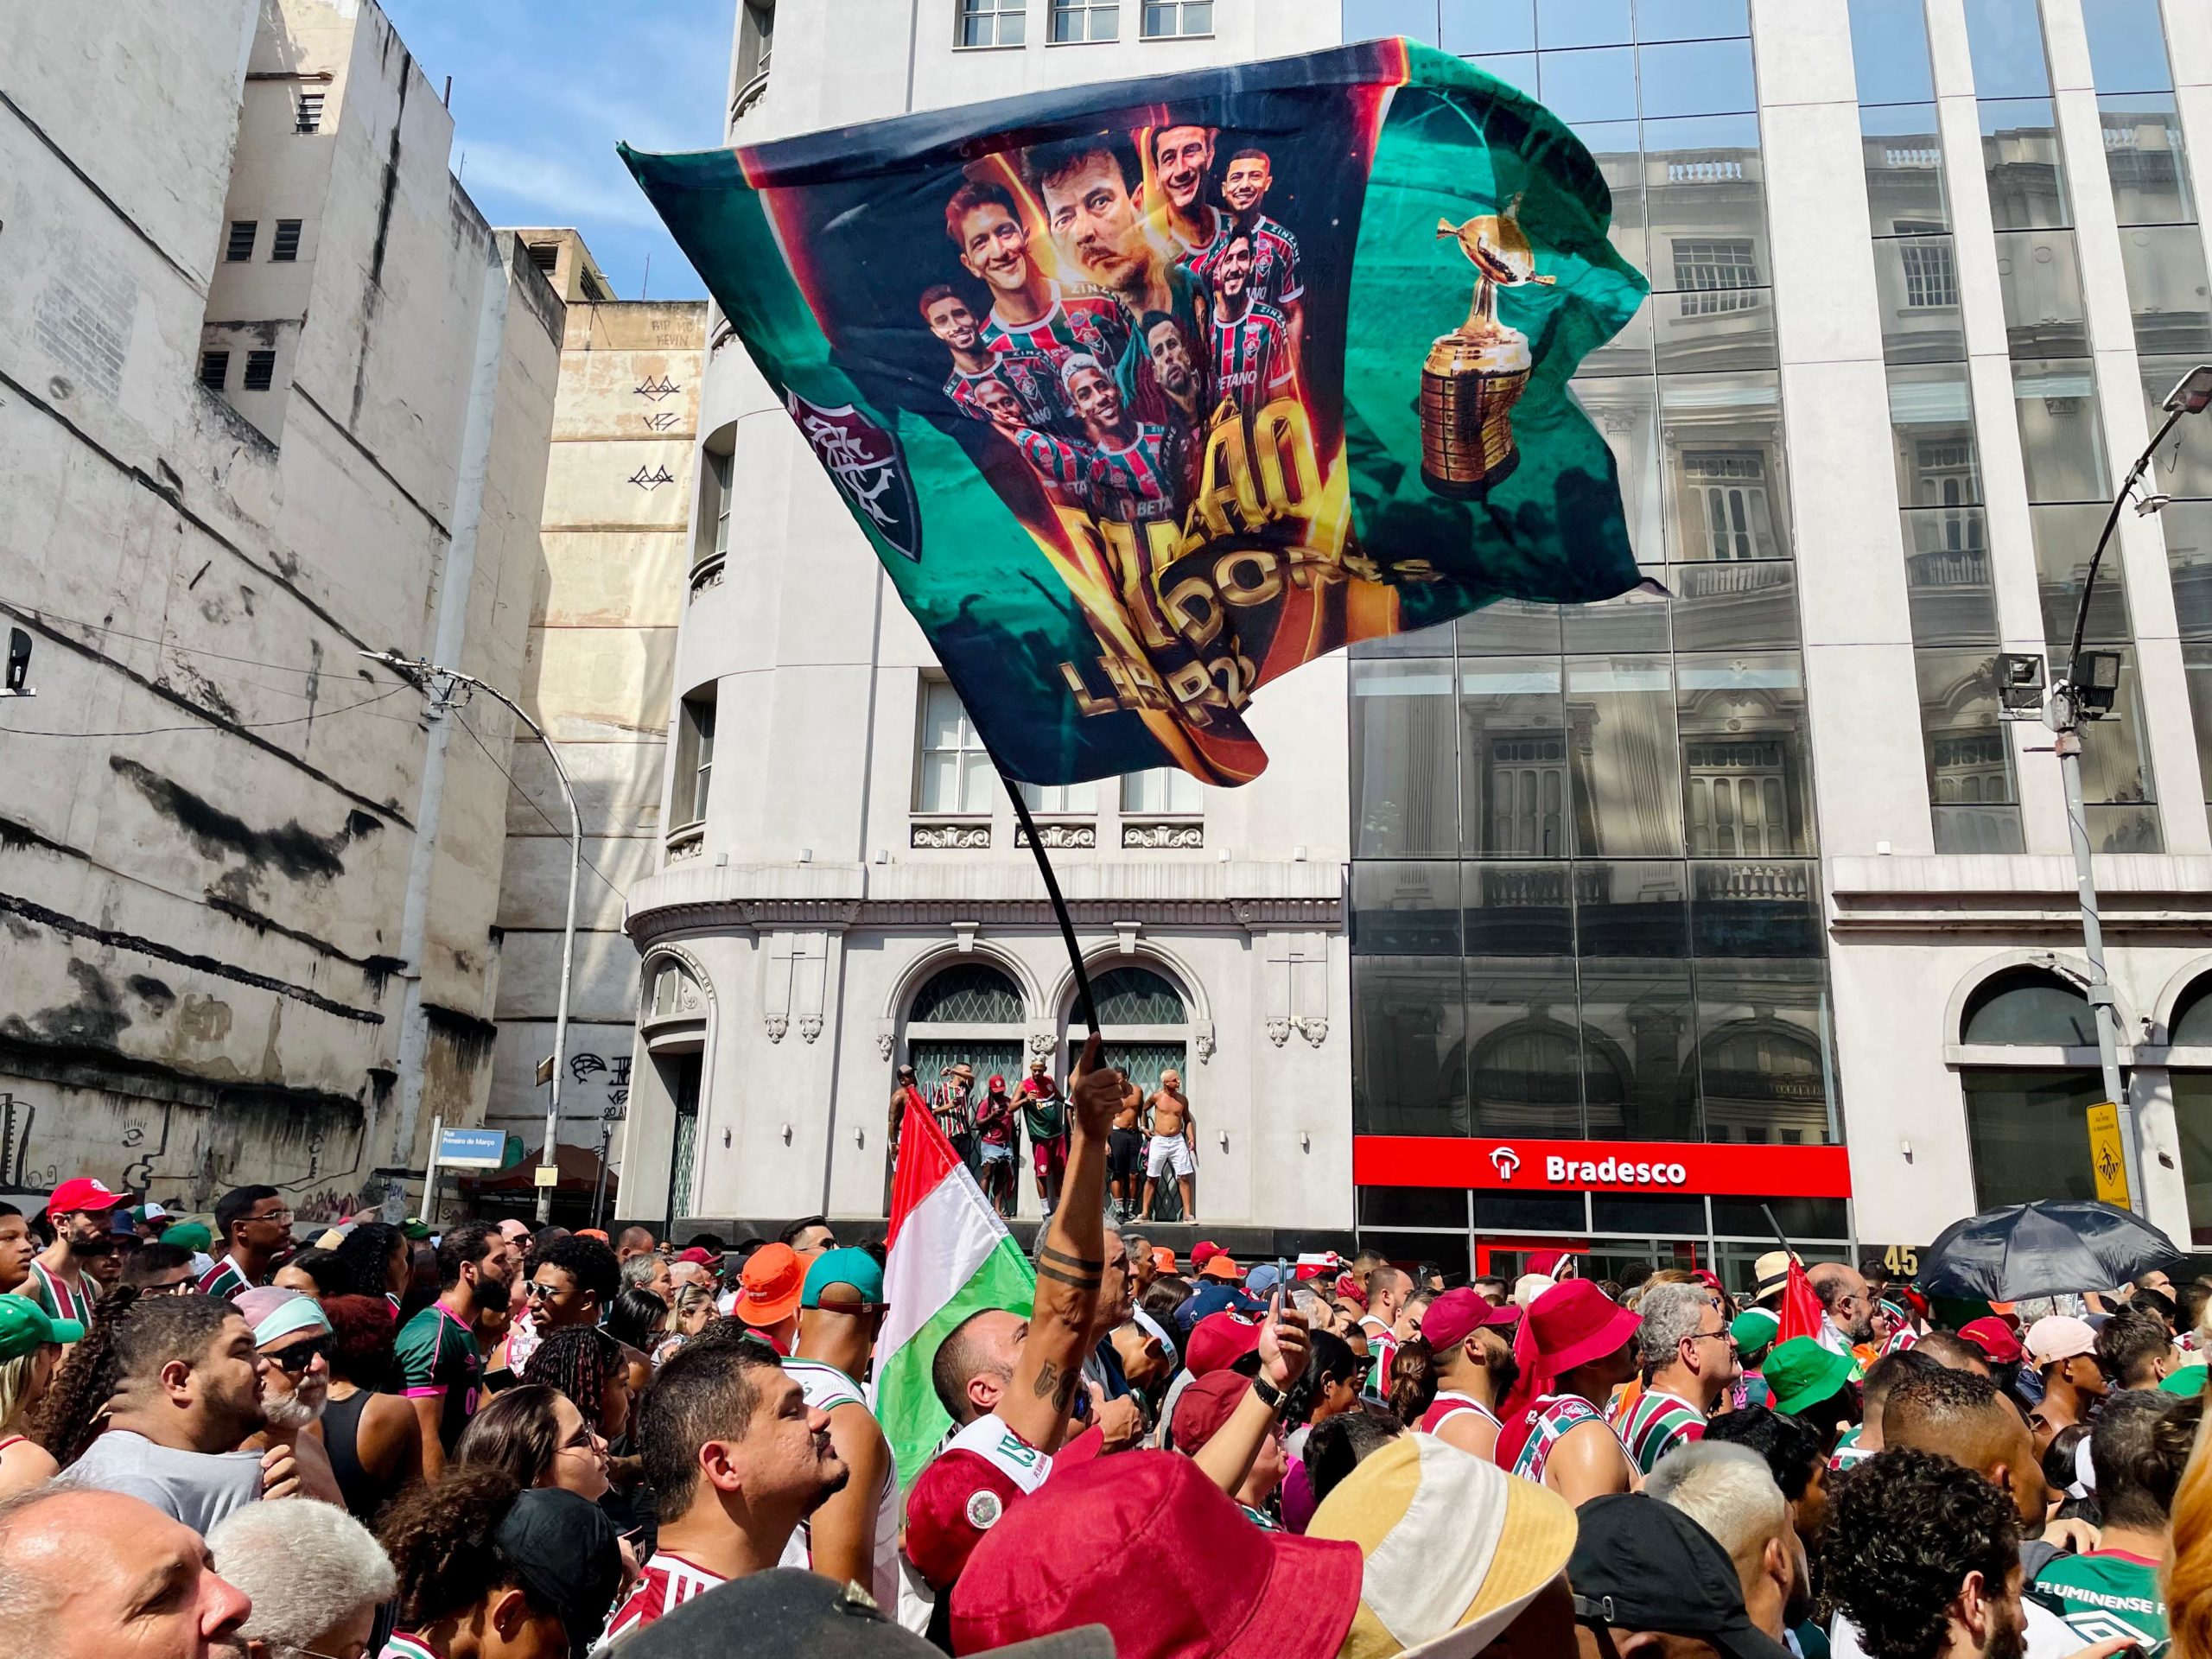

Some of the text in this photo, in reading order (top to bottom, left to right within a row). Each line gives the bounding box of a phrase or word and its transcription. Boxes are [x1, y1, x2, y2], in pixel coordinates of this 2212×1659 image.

[657, 334, 689, 346] KEVIN
[442, 1136, 466, 1145] Primeiro
[475, 1138, 495, 1147] Março
[1546, 1155, 1687, 1184] Bradesco
[1884, 1244, 1918, 1276] 45
[2034, 1580, 2153, 1615] FLUMINENSE
